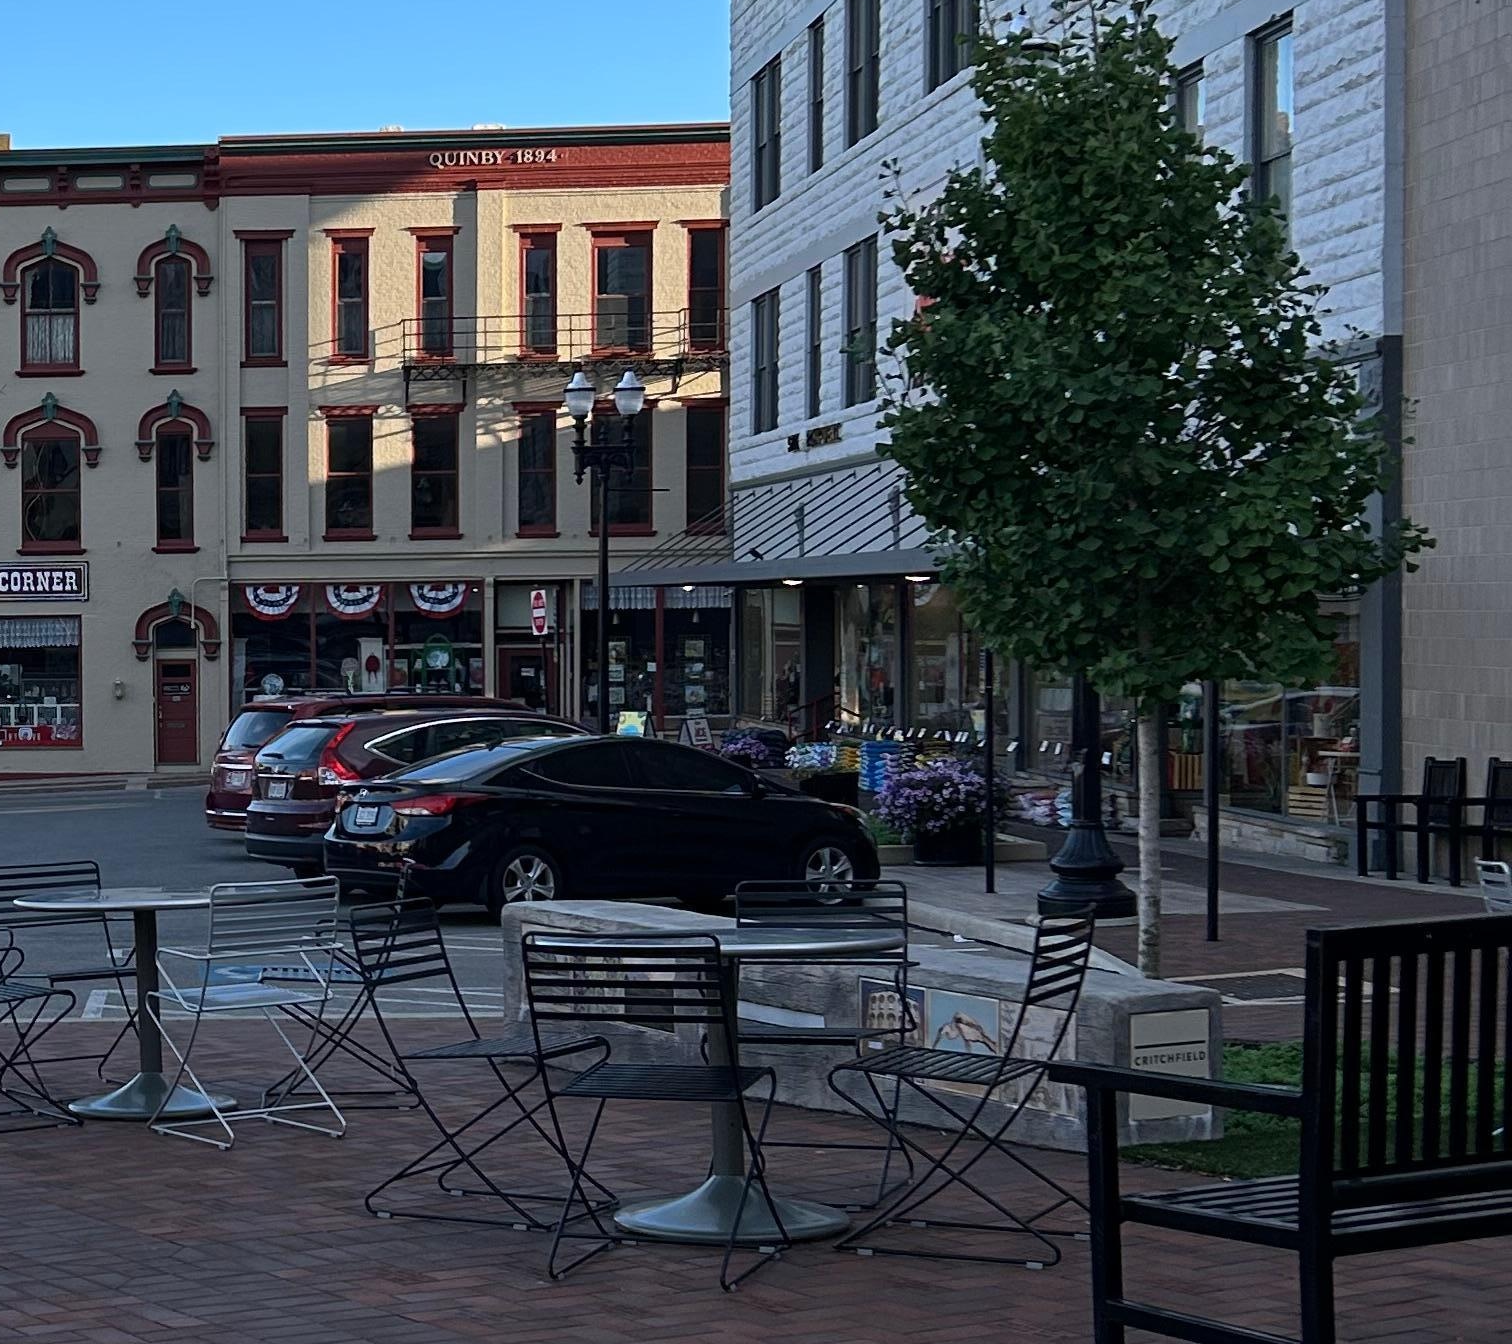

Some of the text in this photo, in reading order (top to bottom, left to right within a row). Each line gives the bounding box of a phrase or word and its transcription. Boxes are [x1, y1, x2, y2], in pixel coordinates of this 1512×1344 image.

[429, 149, 557, 169] QUINBY 1894
[1134, 1050, 1206, 1067] CRITCHFIELD
